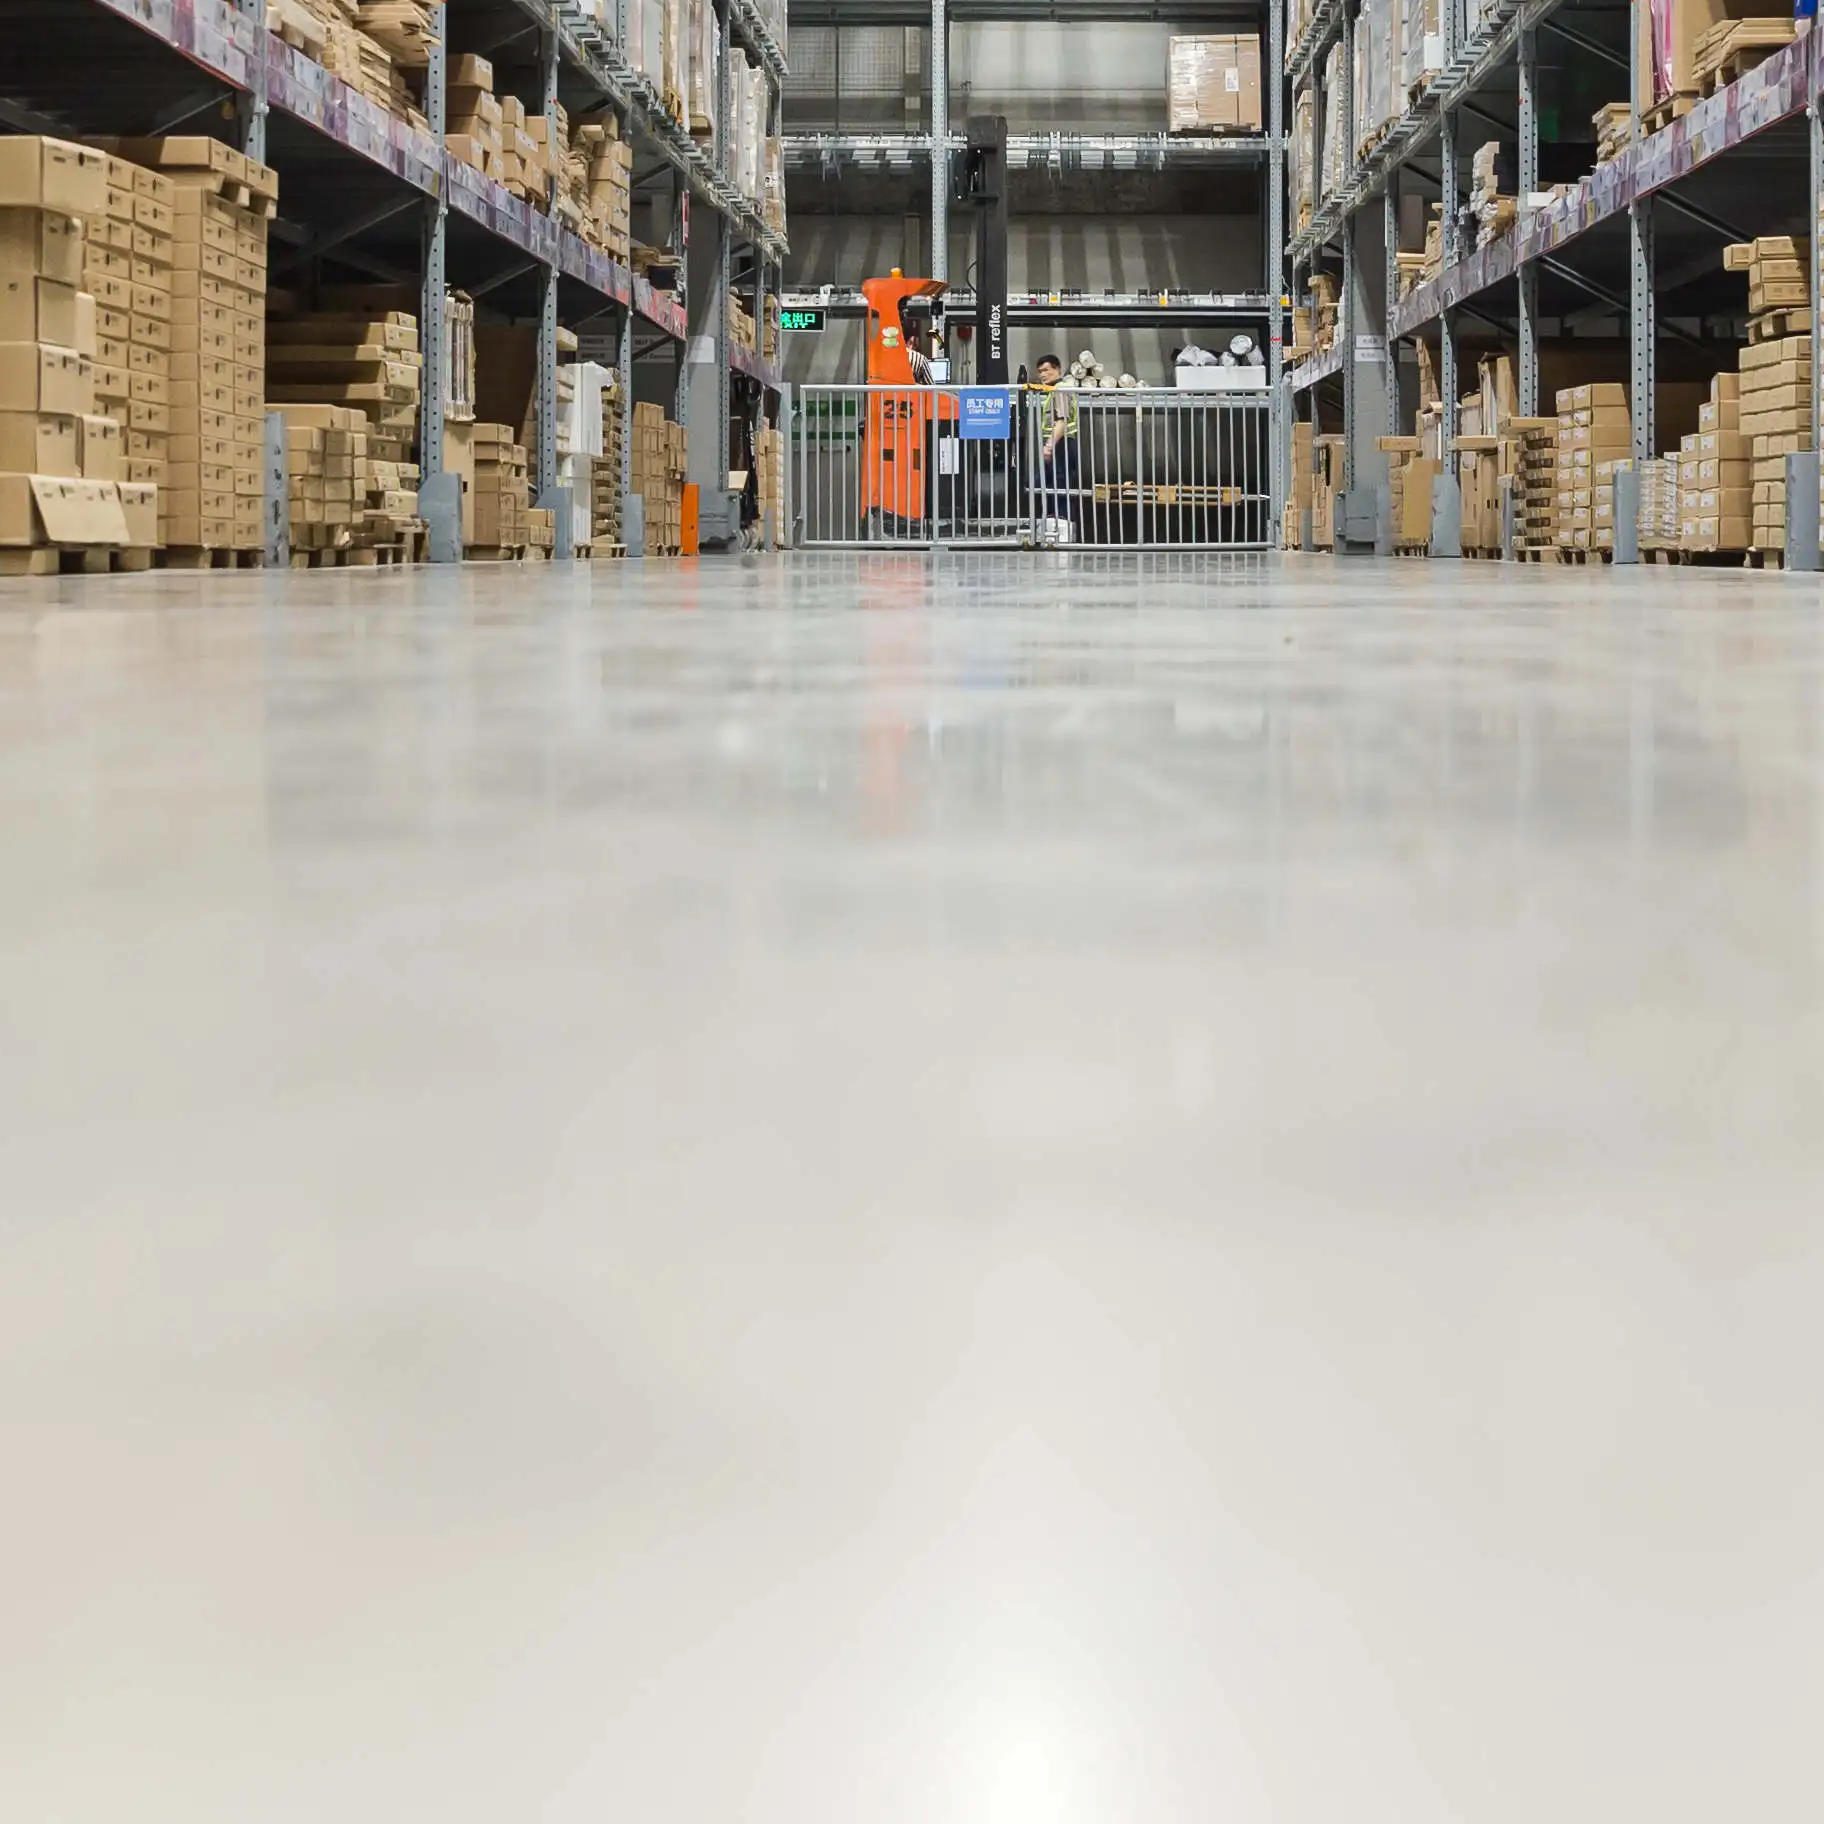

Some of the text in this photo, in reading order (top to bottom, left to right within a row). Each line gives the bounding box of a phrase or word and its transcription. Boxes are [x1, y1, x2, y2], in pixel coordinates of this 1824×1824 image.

[989, 304, 1001, 359] BT reflex
[966, 398, 1004, 409] 员工专用
